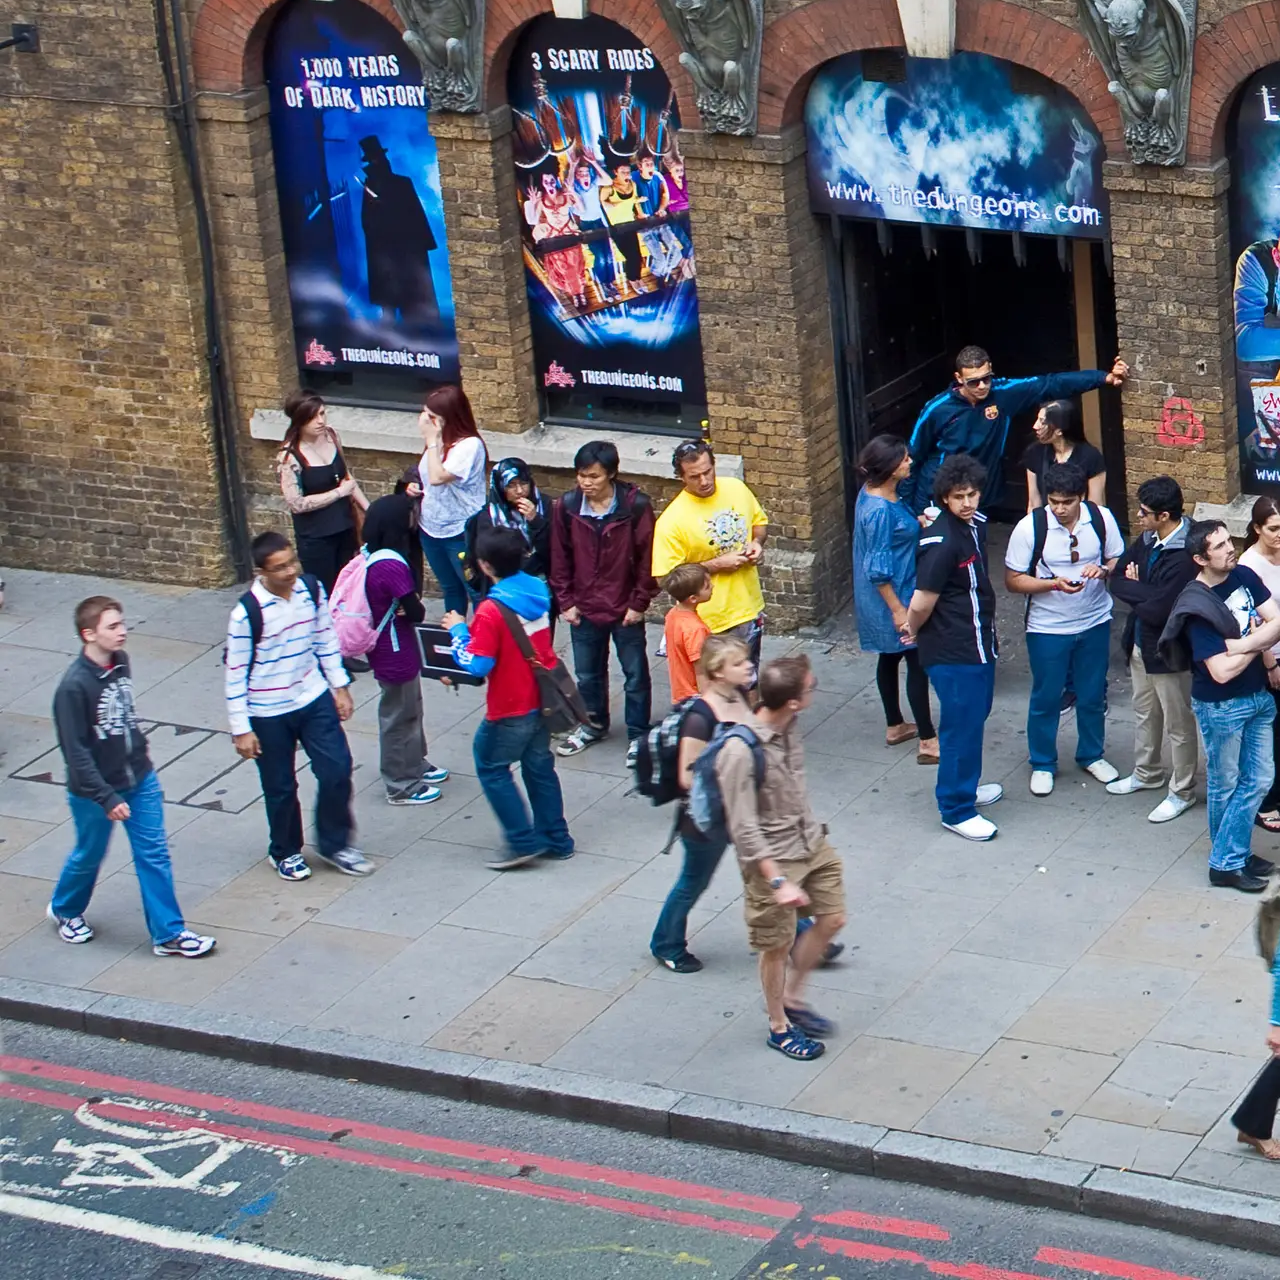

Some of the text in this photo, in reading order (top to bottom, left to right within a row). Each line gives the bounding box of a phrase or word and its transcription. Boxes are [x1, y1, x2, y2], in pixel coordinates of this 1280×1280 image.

[301, 54, 400, 80] 1,000 YEARS
[531, 47, 655, 72] 3 SCARY RIDES
[284, 85, 426, 110] OF DARK HISTORY
[340, 347, 441, 369] THEDUNGEONS.COM
[581, 369, 683, 392] THEDUNGEONS.COM
